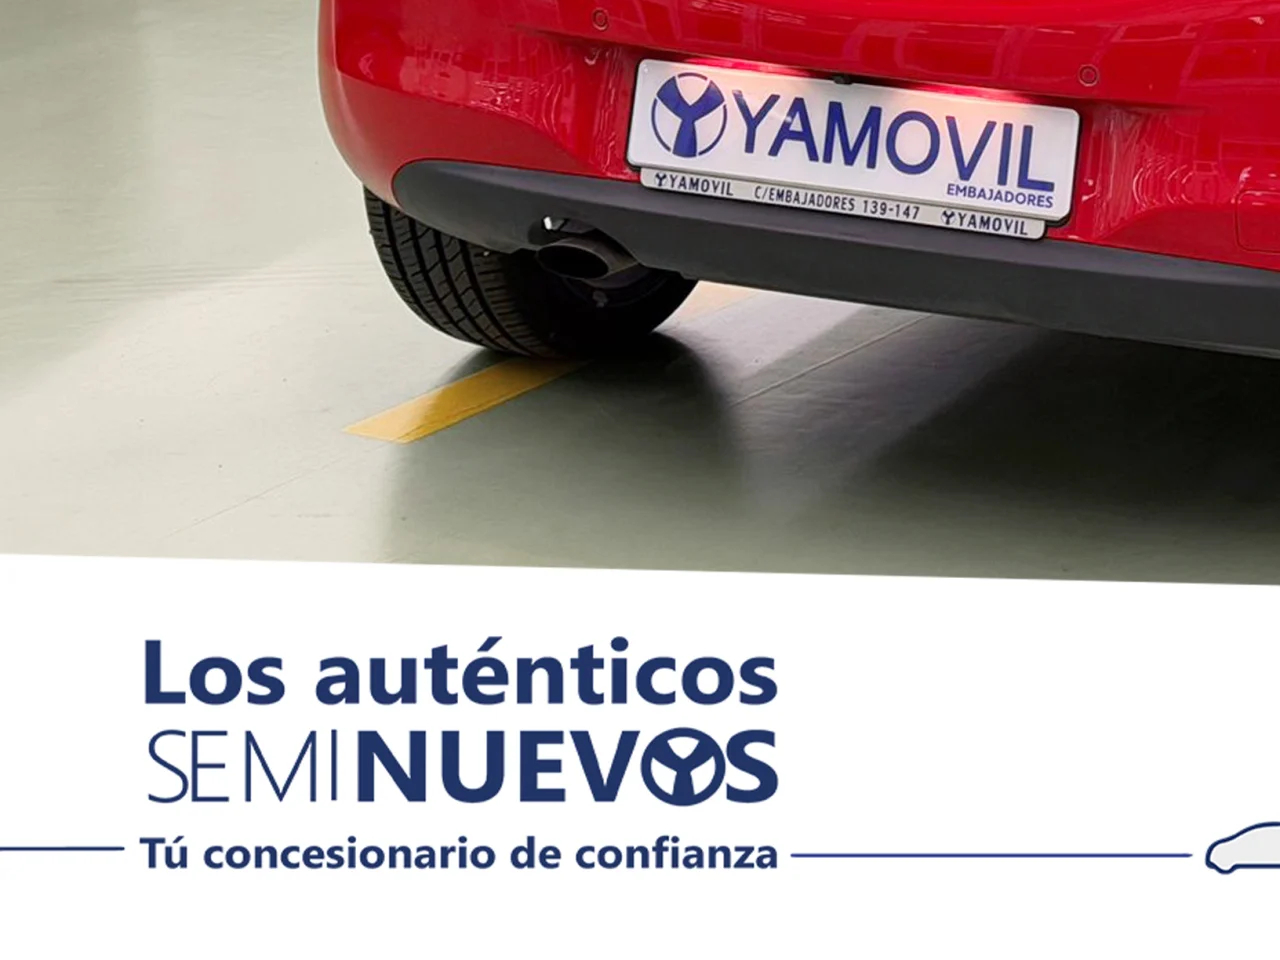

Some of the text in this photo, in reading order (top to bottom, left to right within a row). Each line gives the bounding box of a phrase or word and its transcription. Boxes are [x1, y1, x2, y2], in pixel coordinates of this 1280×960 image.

[732, 89, 1055, 192] YAMOVIL
[669, 174, 1029, 236] YAMOVIL C/EMBAJADORES 139-147 YAMOVIL
[946, 183, 1054, 209] EMBAJADORES
